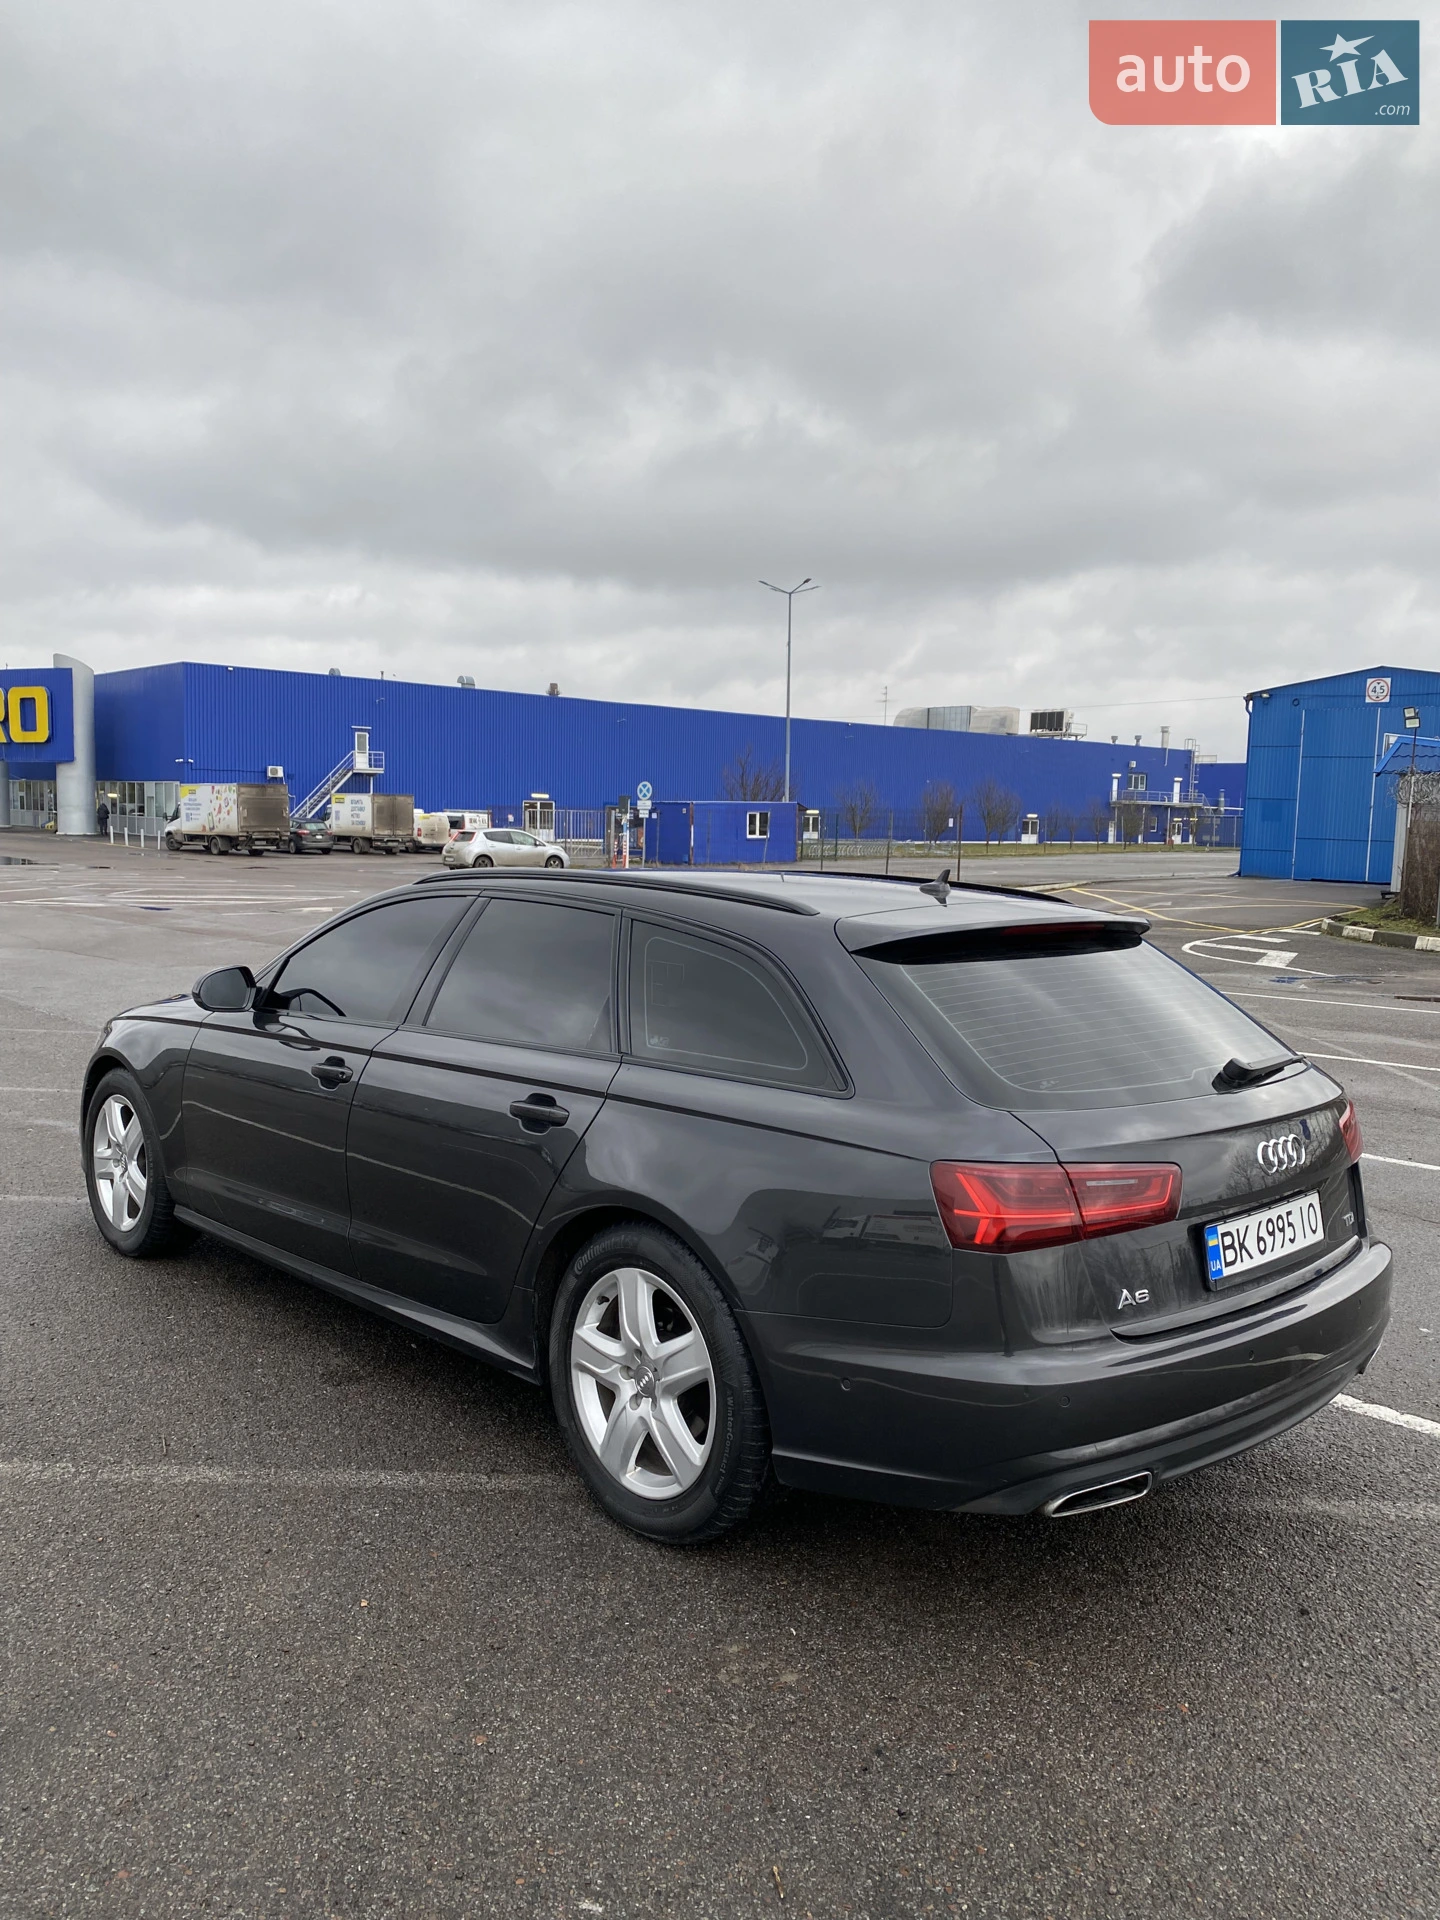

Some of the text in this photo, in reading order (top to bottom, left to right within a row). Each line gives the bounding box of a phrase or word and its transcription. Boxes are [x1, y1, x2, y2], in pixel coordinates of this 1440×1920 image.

[0, 686, 49, 743] O
[574, 1235, 626, 1275] Continental
[1220, 1224, 1254, 1268] BK
[1256, 1210, 1296, 1255] 6995
[1210, 1259, 1222, 1272] UA
[1118, 1288, 1150, 1310] A6
[720, 1396, 734, 1474] WinterContact
